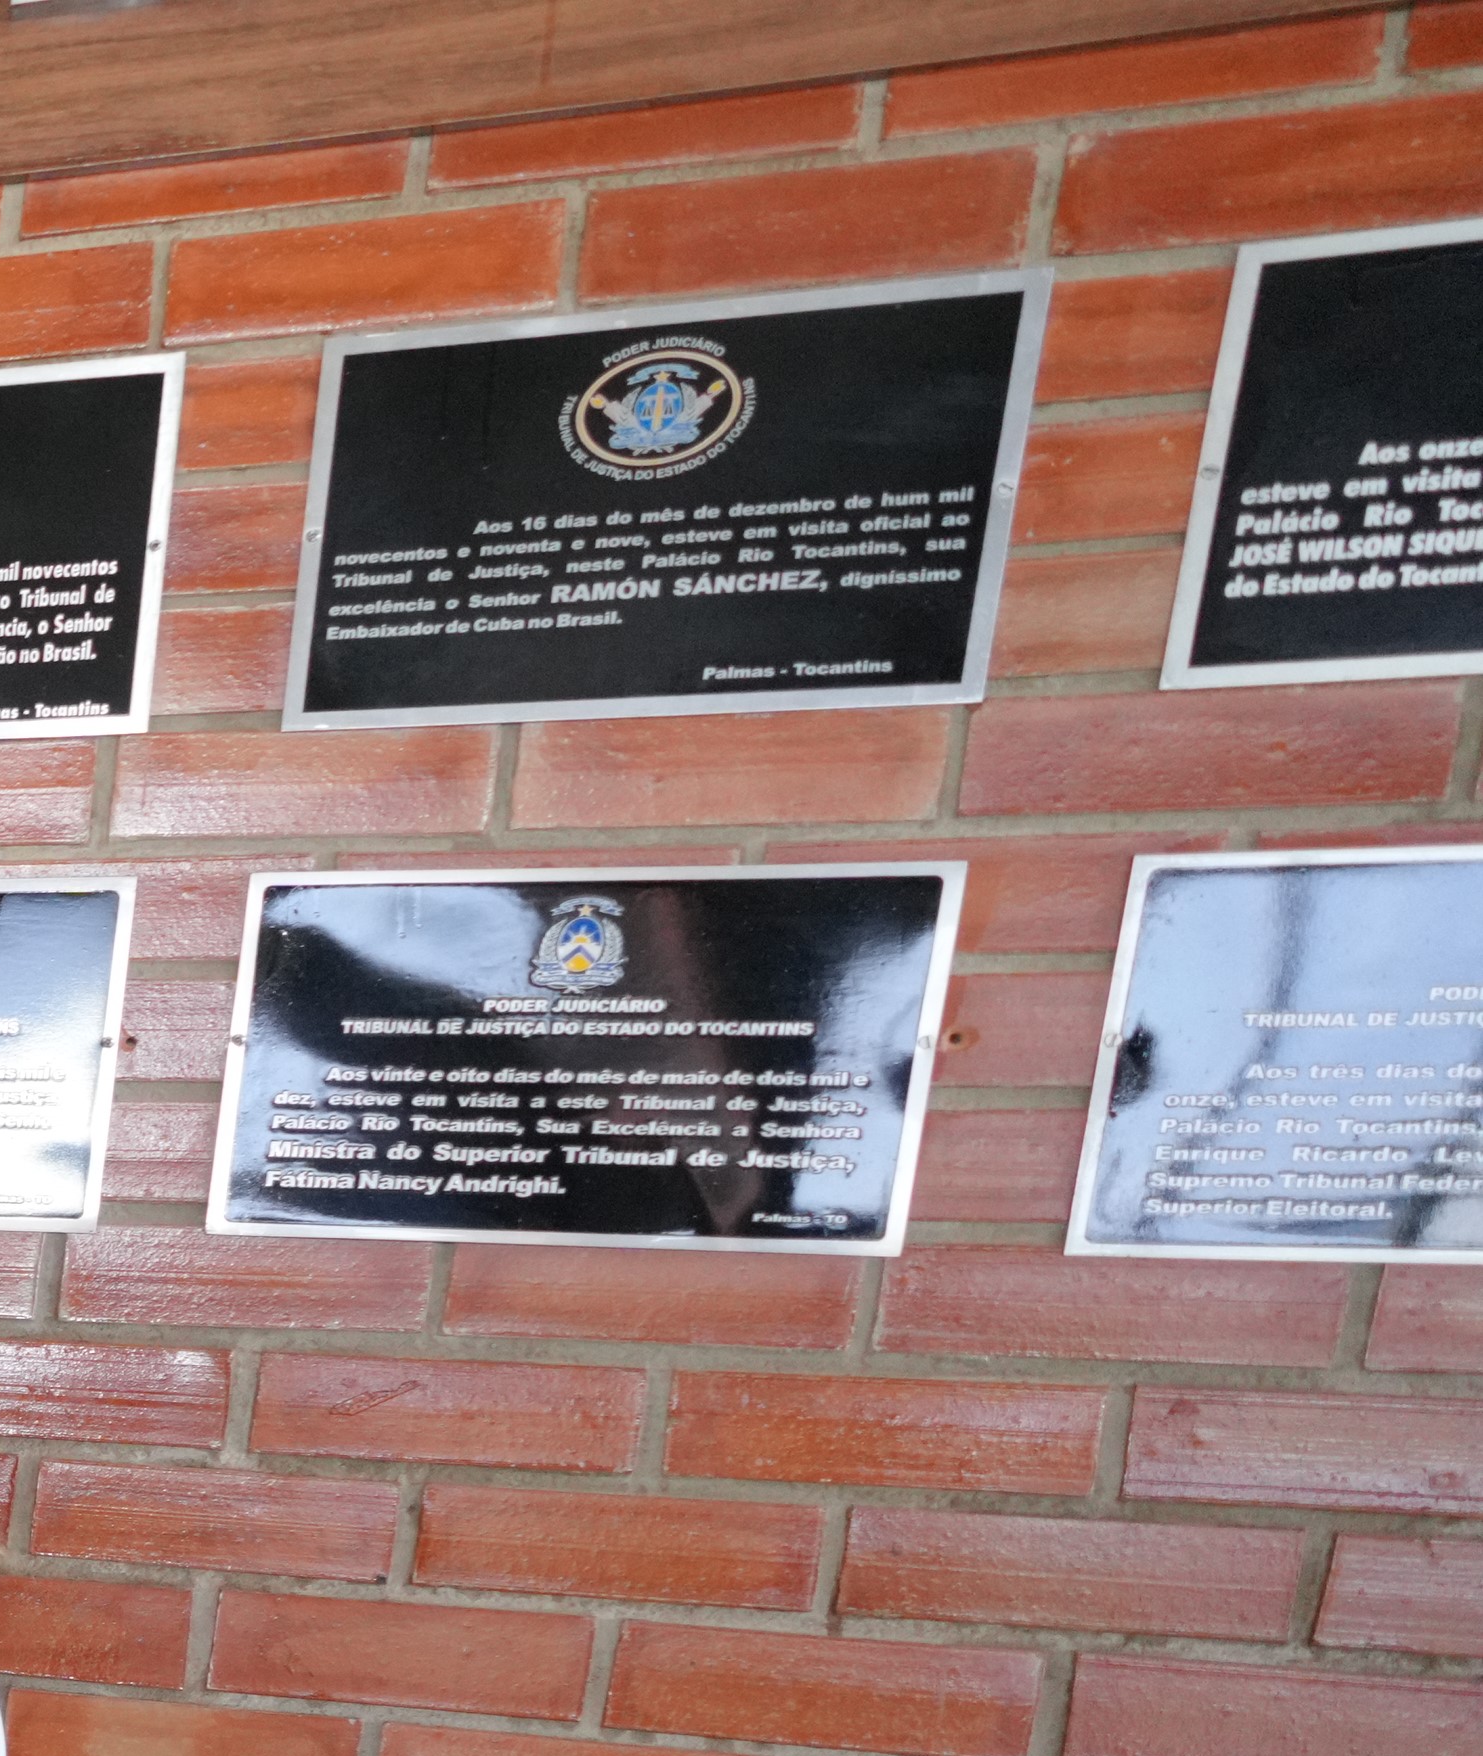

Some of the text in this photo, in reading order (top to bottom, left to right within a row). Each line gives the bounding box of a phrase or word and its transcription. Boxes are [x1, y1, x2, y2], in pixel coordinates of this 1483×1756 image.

[602, 336, 726, 368] PODER JUDICIÁRIO
[1358, 442, 1410, 465] Aos
[1240, 465, 1481, 505] esteve em visita
[1235, 506, 1339, 536] Palácio
[1363, 501, 1412, 527] Rio
[1228, 536, 1292, 567] JOSÉ
[1298, 533, 1404, 562] WILSON
[328, 597, 435, 616] excelência
[445, 598, 459, 609] o
[468, 592, 541, 608] Senhor
[550, 576, 660, 603] RAMÓN
[672, 569, 828, 596] SÁNCHEZ,
[1224, 574, 1259, 598] do
[1262, 567, 1355, 595] Estado
[1357, 564, 1395, 590] do
[326, 610, 622, 640] Embaixador de Cuba no Brasil.
[18, 648, 40, 663] no
[42, 639, 96, 662] Brasil.
[702, 666, 775, 680] Palmas
[792, 659, 892, 675] Tocantins
[483, 996, 666, 1012] PODER JUDICIÁRIO
[1244, 1013, 1357, 1027] TRIBUNAL
[1368, 1013, 1396, 1025] DE
[1155, 1145, 1408, 1163] Enrique Ricardo
[265, 1167, 565, 1197] Fátima Nancy Andrighi.
[1148, 1171, 1483, 1191] Supremo Tribunal Feder
[752, 1212, 809, 1225] Palmas
[826, 1215, 846, 1223] TO
[1143, 1198, 1393, 1218] Superior Eleitoral.
